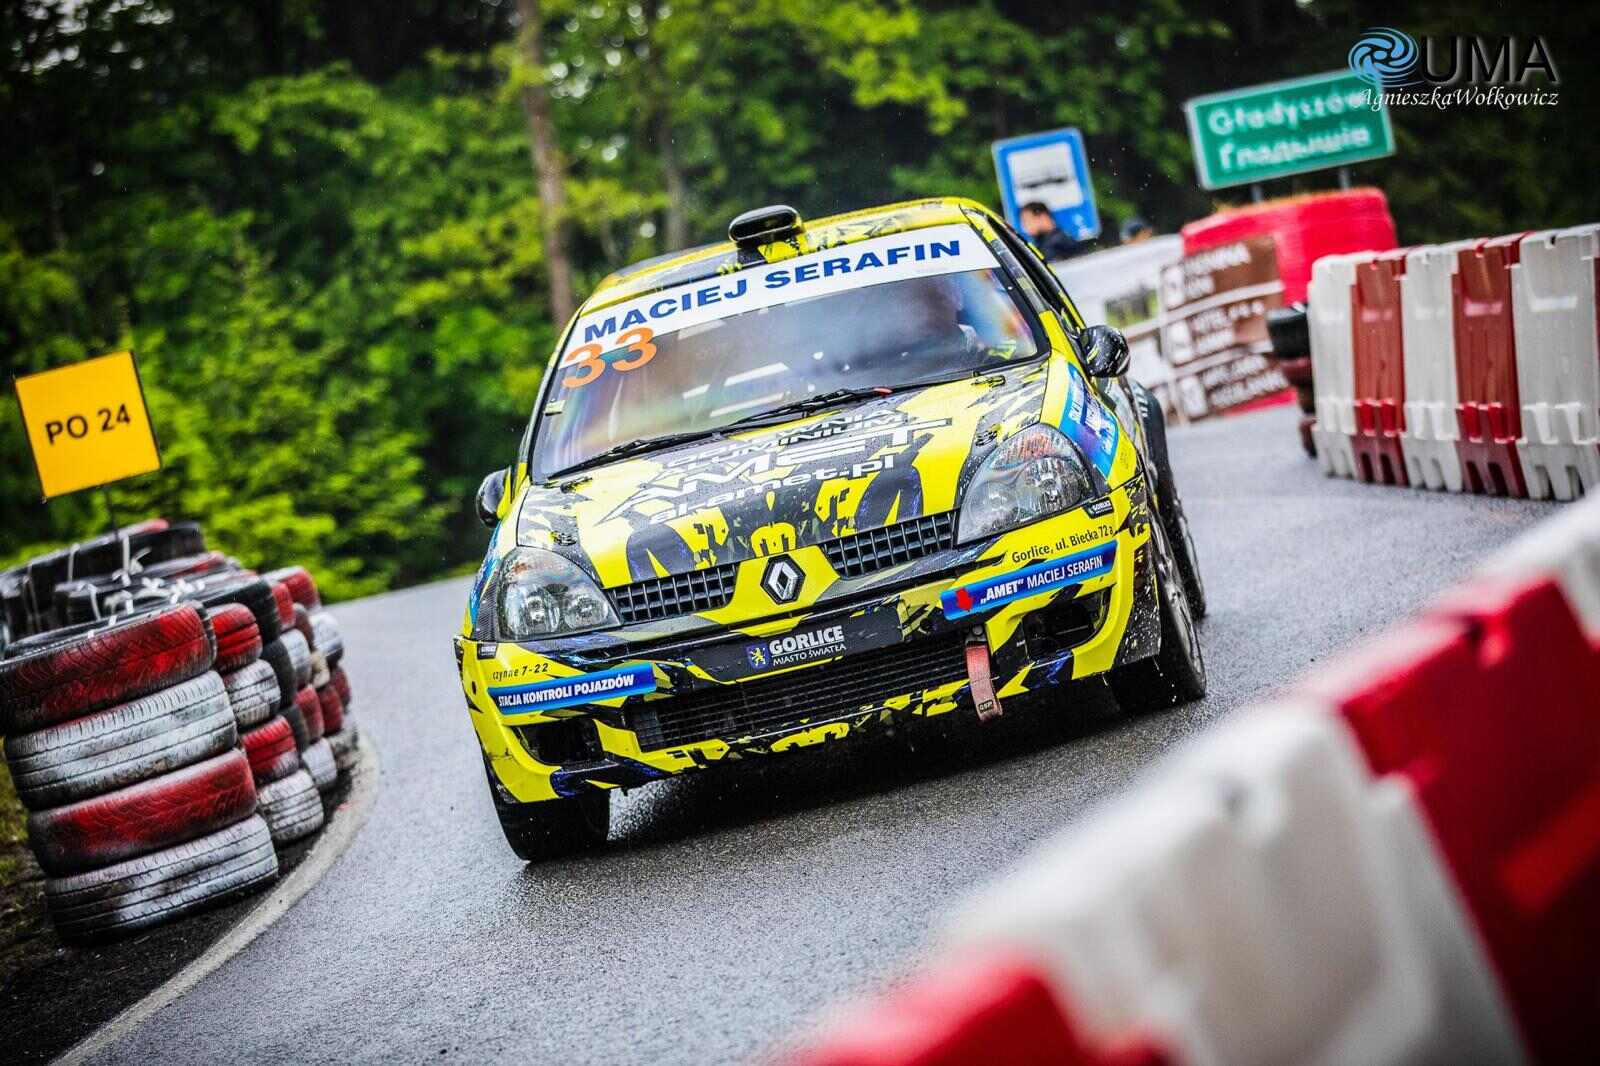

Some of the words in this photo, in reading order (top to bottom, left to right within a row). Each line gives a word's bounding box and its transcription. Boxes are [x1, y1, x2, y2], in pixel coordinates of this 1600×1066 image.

[583, 278, 748, 343] MACIEJ
[765, 240, 961, 289] SERAFIN
[562, 326, 657, 389] 33
[45, 414, 88, 445] PO
[98, 403, 131, 432] 24
[1012, 545, 1054, 563] Gorlice,
[1055, 540, 1070, 551] ul.
[1072, 530, 1100, 546] Biecka
[1027, 569, 1065, 590] MACIEJ
[1067, 555, 1103, 577] SERAFIN
[769, 625, 844, 655] GORLICE
[773, 652, 807, 667] MIASTO
[808, 643, 847, 659] ŚWIATŁA
[497, 691, 522, 708] STACJA
[523, 685, 573, 704] KONTROLI
[574, 673, 634, 698] POJAZDÓW
